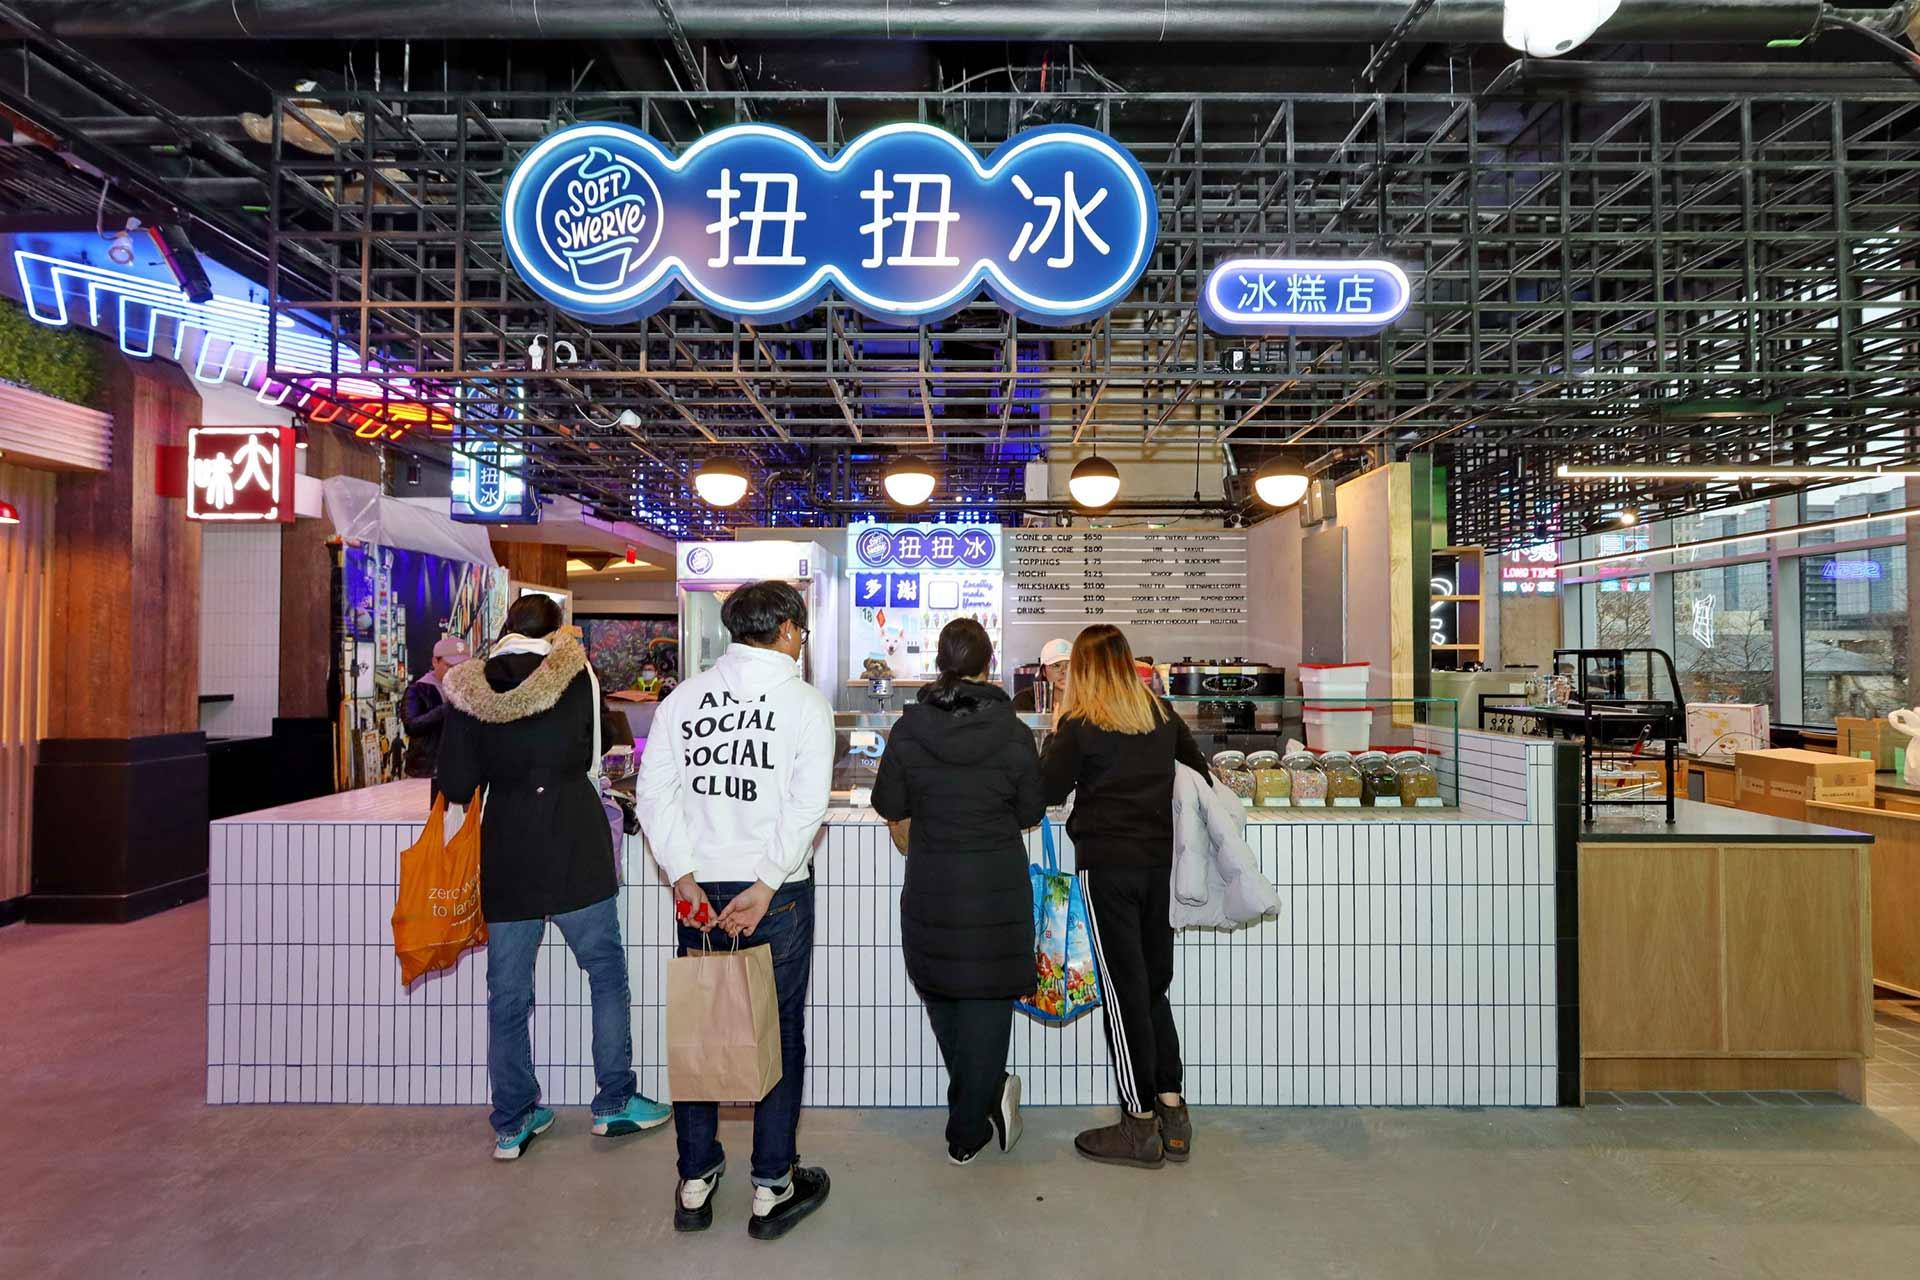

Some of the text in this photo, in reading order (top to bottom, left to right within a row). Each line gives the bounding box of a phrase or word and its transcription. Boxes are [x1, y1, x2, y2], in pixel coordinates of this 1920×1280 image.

[567, 172, 622, 217] SOFT
[706, 167, 1111, 268] 扭扭冰
[554, 203, 647, 249] SWERVE
[1237, 274, 1376, 313] 冰糕店
[1015, 533, 1040, 541] CONE
[898, 535, 987, 560] 扭扭冰
[1015, 545, 1047, 553] WAFFLE
[1017, 558, 1061, 566] TOPPINGS
[1017, 570, 1047, 578] MOCHI
[1503, 567, 1557, 578] LONG TIME
[1017, 583, 1070, 591] MILKSHAKES
[1018, 595, 1043, 603] PINTS
[1016, 607, 1046, 615] DRINKS
[682, 709, 776, 740] SOCIAL
[685, 739, 775, 770] SOCIAL
[692, 775, 758, 802] CLUB
[432, 903, 448, 917] to
